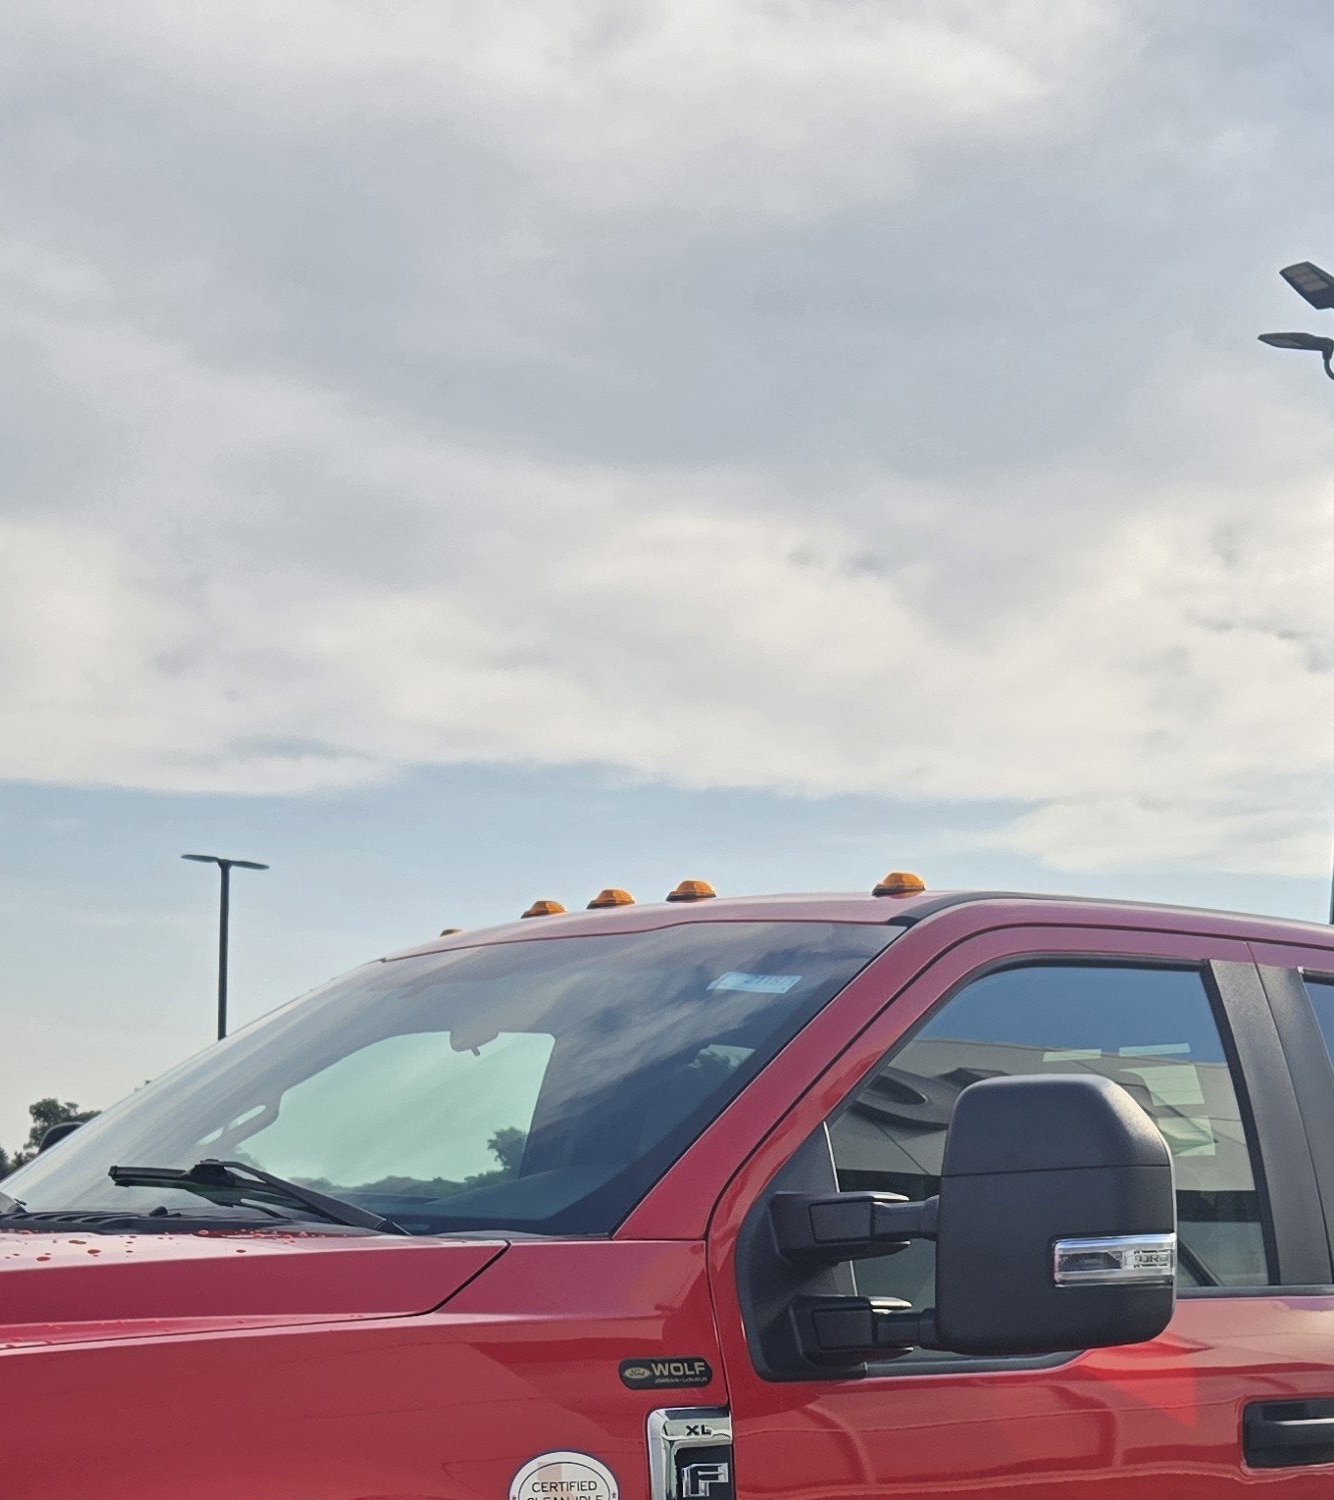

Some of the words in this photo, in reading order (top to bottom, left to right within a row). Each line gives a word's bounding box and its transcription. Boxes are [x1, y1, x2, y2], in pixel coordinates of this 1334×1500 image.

[651, 1362, 705, 1376] WOLF
[686, 1424, 712, 1436] XL
[531, 1480, 598, 1493] CERTIFIED
